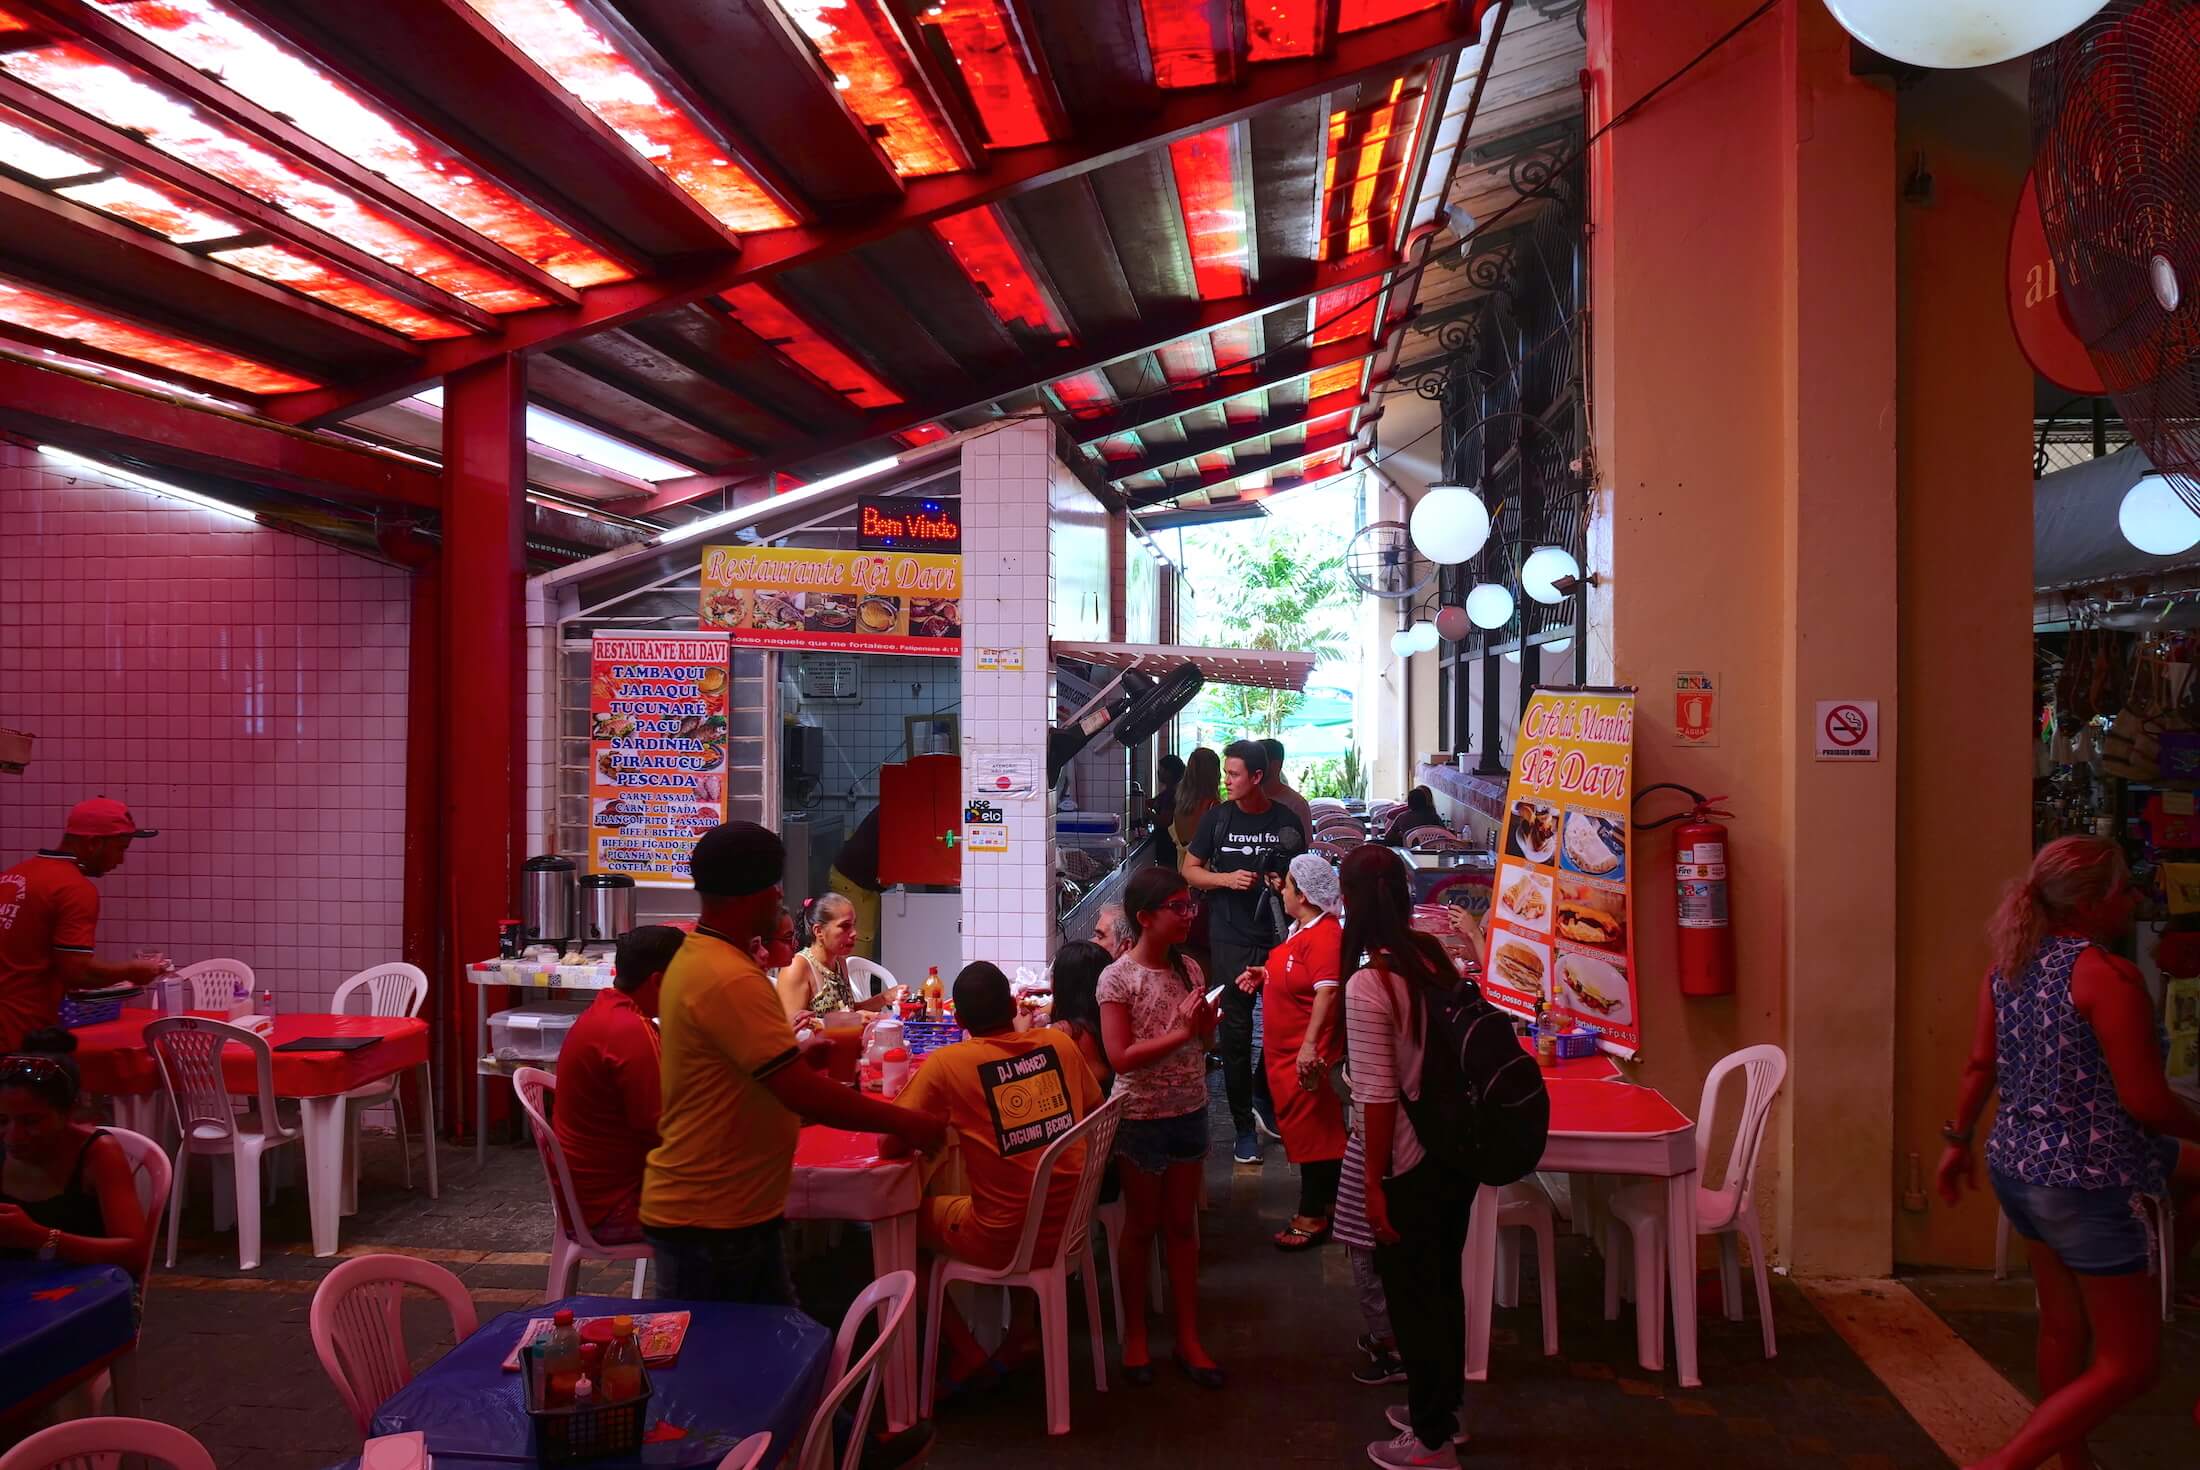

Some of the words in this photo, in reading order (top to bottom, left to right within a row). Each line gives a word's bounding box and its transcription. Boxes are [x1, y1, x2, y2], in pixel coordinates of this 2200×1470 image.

[864, 507, 902, 536] Bem
[905, 512, 957, 540] Vindo
[707, 549, 844, 587] Restaurante
[851, 555, 893, 593] Rei
[895, 558, 958, 592] Davi
[595, 640, 678, 661] RESTAURANTE
[679, 642, 699, 662] REI
[699, 643, 728, 662] DAVI
[764, 637, 805, 646] naquele
[808, 640, 828, 648] que
[942, 646, 960, 654] 4:13
[613, 666, 705, 680] TAMBAQUI
[620, 684, 699, 698] JARAQUI
[610, 700, 706, 716] TUCUNARÉ
[635, 720, 681, 732] PACU
[612, 738, 704, 751] SARDINHA
[612, 756, 702, 769] PIRARUCU
[1520, 746, 1562, 793] Rei
[1560, 749, 1630, 800] Davi
[617, 774, 697, 787] PESCADA
[620, 792, 653, 801] CARNE
[656, 793, 695, 802] ASSADA
[616, 804, 650, 813] CARNE
[652, 805, 697, 815] GUISADA
[969, 799, 991, 809] use
[594, 815, 638, 825] FRANGO
[638, 816, 668, 825] FRITO
[670, 817, 677, 826] E
[679, 817, 720, 827] ASSADO
[982, 812, 1002, 822] elo
[620, 827, 643, 836] BIFE
[652, 828, 694, 838] BISTECA
[1229, 832, 1262, 842] travel
[602, 839, 624, 847] BIFE
[625, 839, 638, 848] DE
[642, 838, 678, 849] FÍGADO
[681, 840, 689, 849] E
[608, 851, 652, 861] PICANHA
[655, 852, 668, 861] NA
[672, 852, 694, 862] CHA
[608, 863, 653, 872] COSTELA
[656, 864, 668, 872] DE
[671, 864, 692, 873] POR
[1502, 994, 1522, 1006] posso
[997, 1062, 1013, 1083] DJ
[1002, 1125, 1043, 1151] LAGUNA
[1045, 1114, 1073, 1139] BEACH
